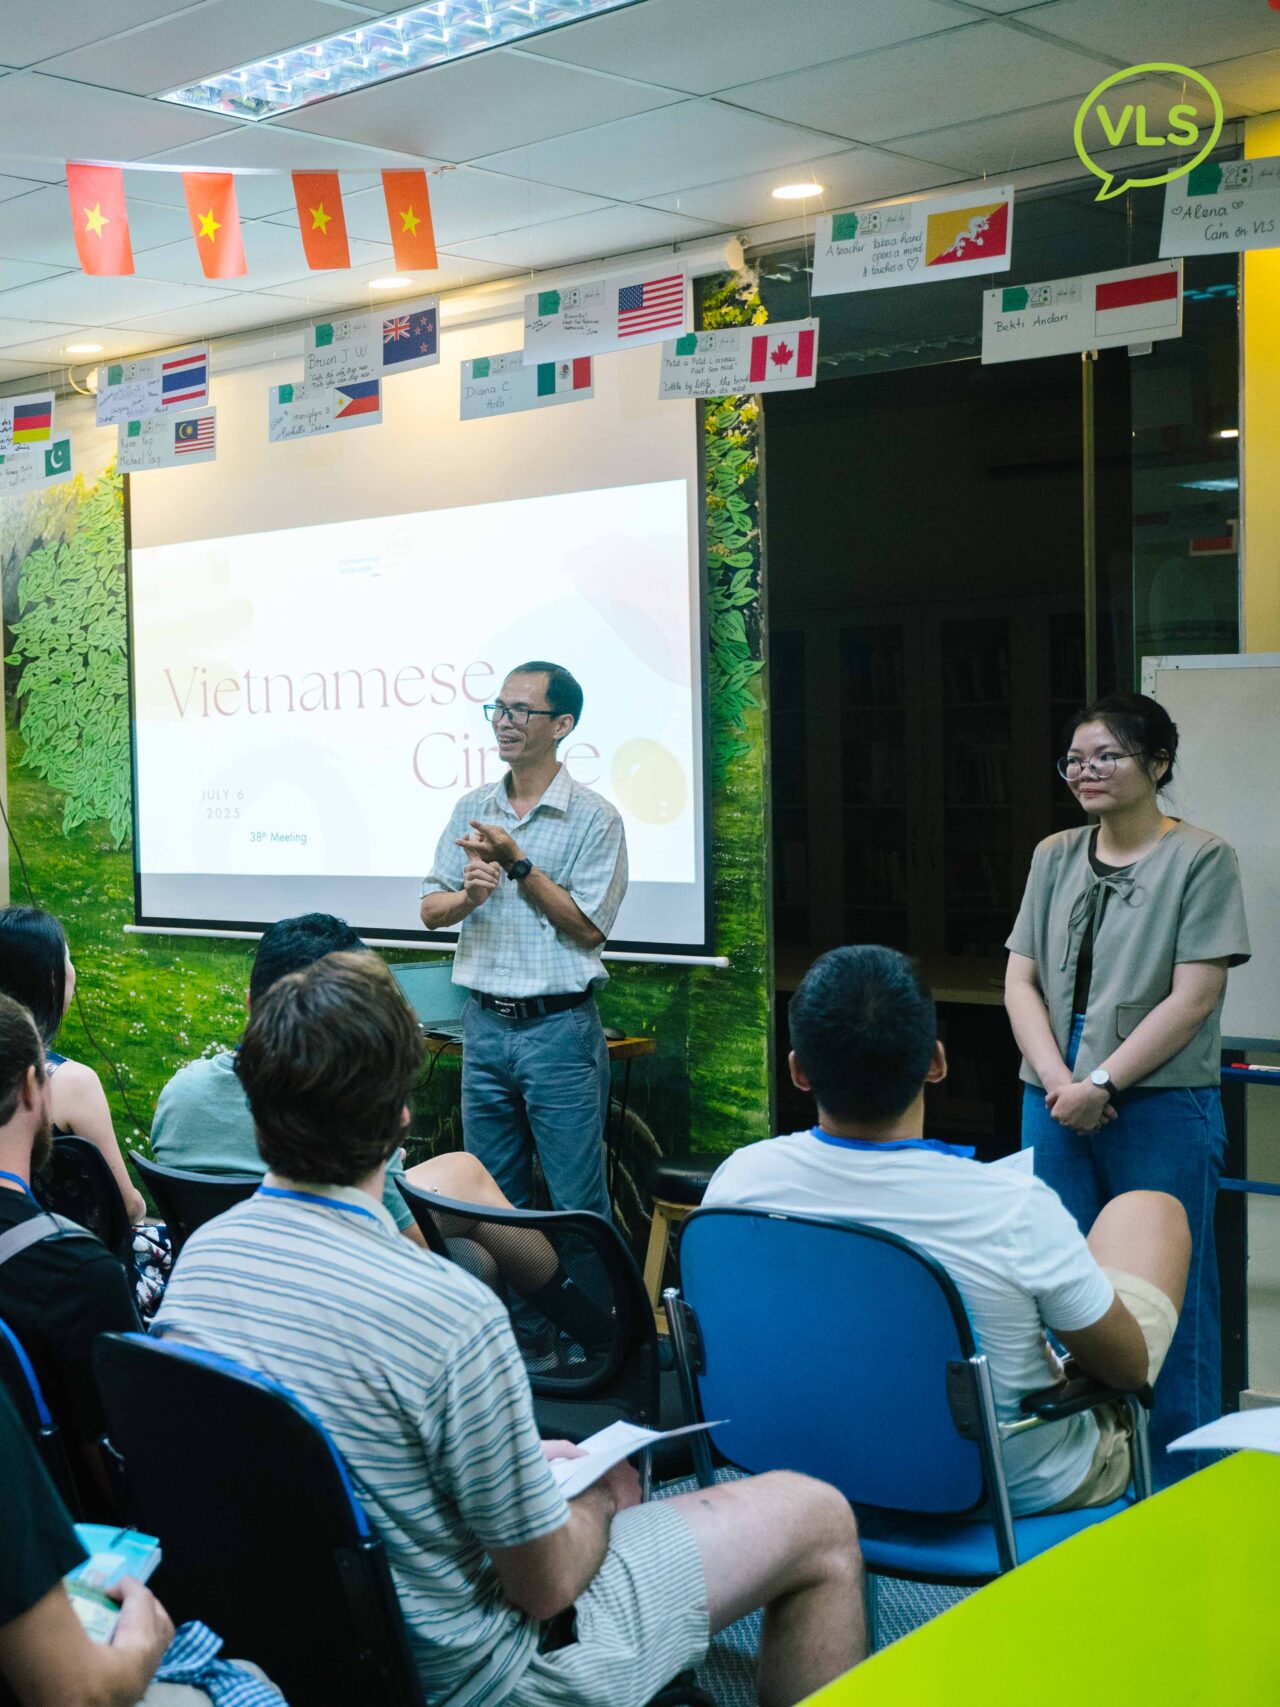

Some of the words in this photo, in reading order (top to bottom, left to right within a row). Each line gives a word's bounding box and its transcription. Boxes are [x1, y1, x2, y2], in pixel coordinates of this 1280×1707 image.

[1182, 204, 1228, 220] Alena
[1253, 219, 1275, 234] VLS
[900, 231, 922, 244] hand
[903, 243, 922, 255] mind
[685, 381, 693, 394] by
[720, 377, 730, 385] the
[464, 386, 496, 400] Diana
[164, 660, 495, 720] Vietnamese
[412, 731, 601, 790] Cire
[201, 789, 230, 802] JULY
[237, 789, 245, 800] 6
[206, 807, 240, 819] 2025
[270, 831, 308, 845] Meeting
